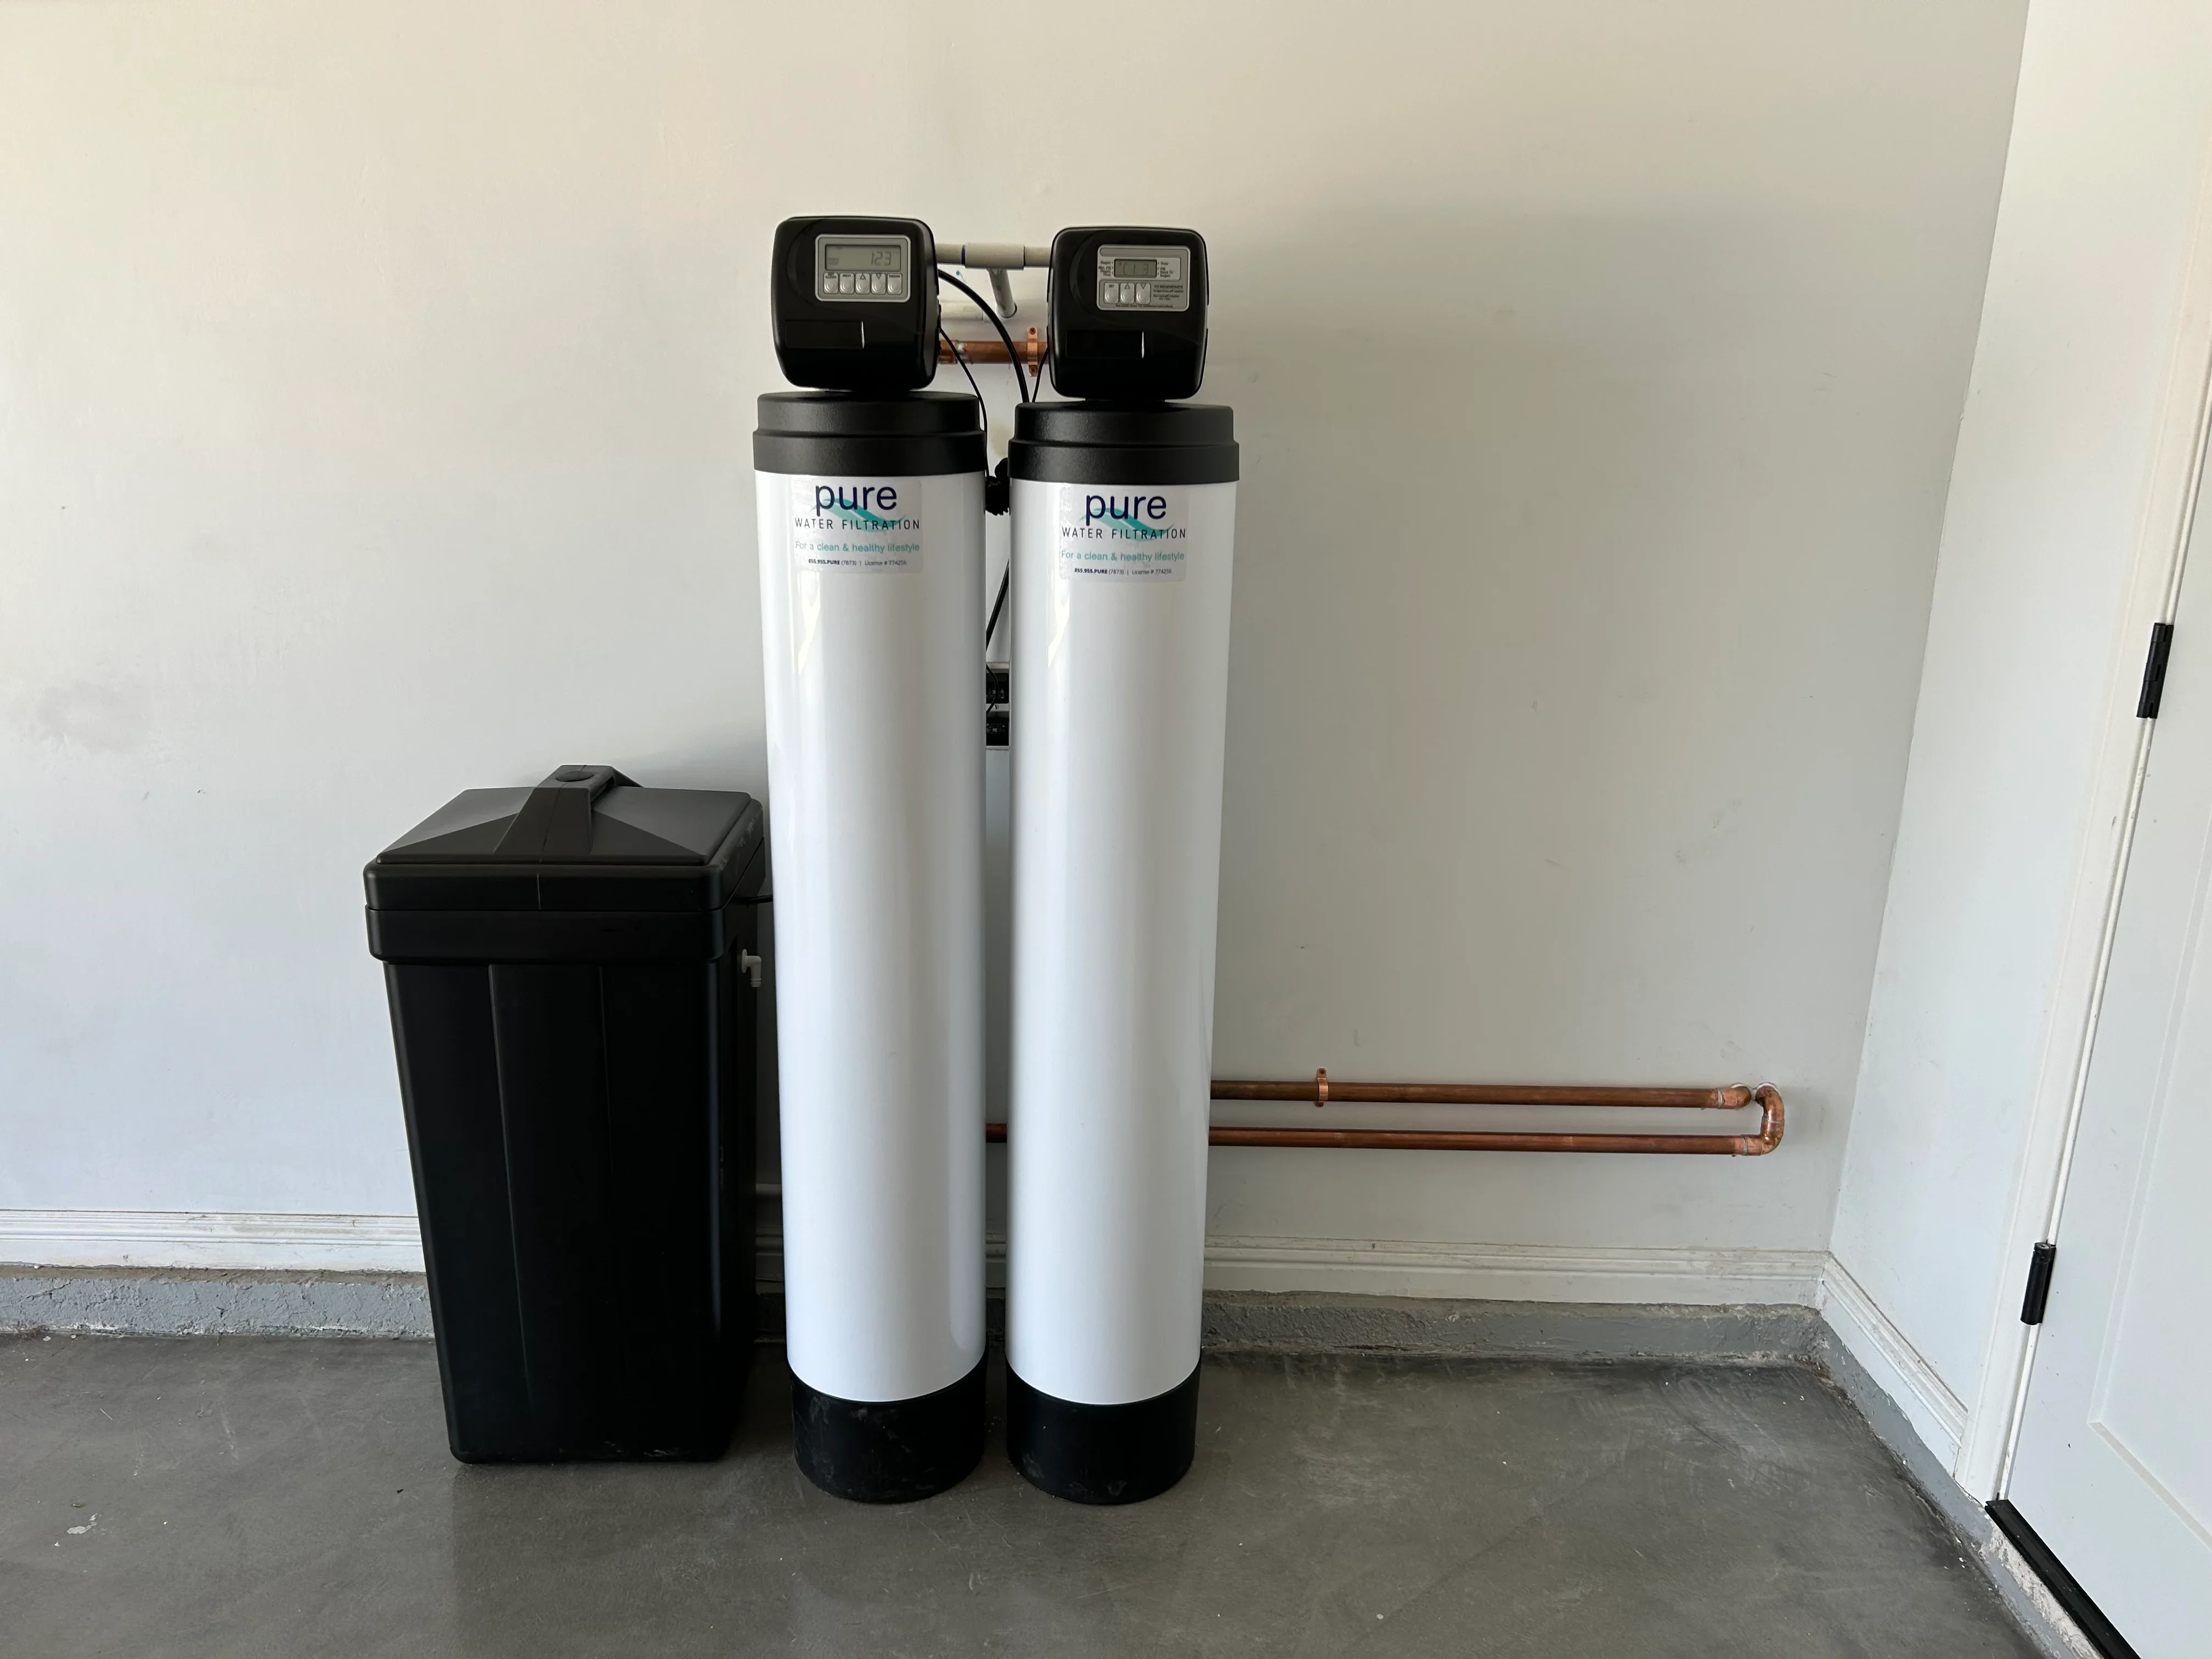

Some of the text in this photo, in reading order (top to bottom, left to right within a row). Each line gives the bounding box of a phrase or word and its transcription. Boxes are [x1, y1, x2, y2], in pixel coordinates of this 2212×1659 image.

[815, 485, 897, 517] pure
[1086, 495, 1167, 527] pure
[795, 517, 919, 530] WATER FILTRATION
[1062, 527, 1186, 539] WATER FILTRATION
[795, 541, 807, 550] For
[817, 543, 839, 551] clean
[843, 543, 849, 551] &
[852, 543, 885, 554] healthy
[888, 543, 919, 553] lifestyle
[1062, 550, 1074, 558] For
[1084, 551, 1108, 560] clean
[1120, 553, 1152, 562] healthy
[1155, 552, 1184, 562] lifestyle
